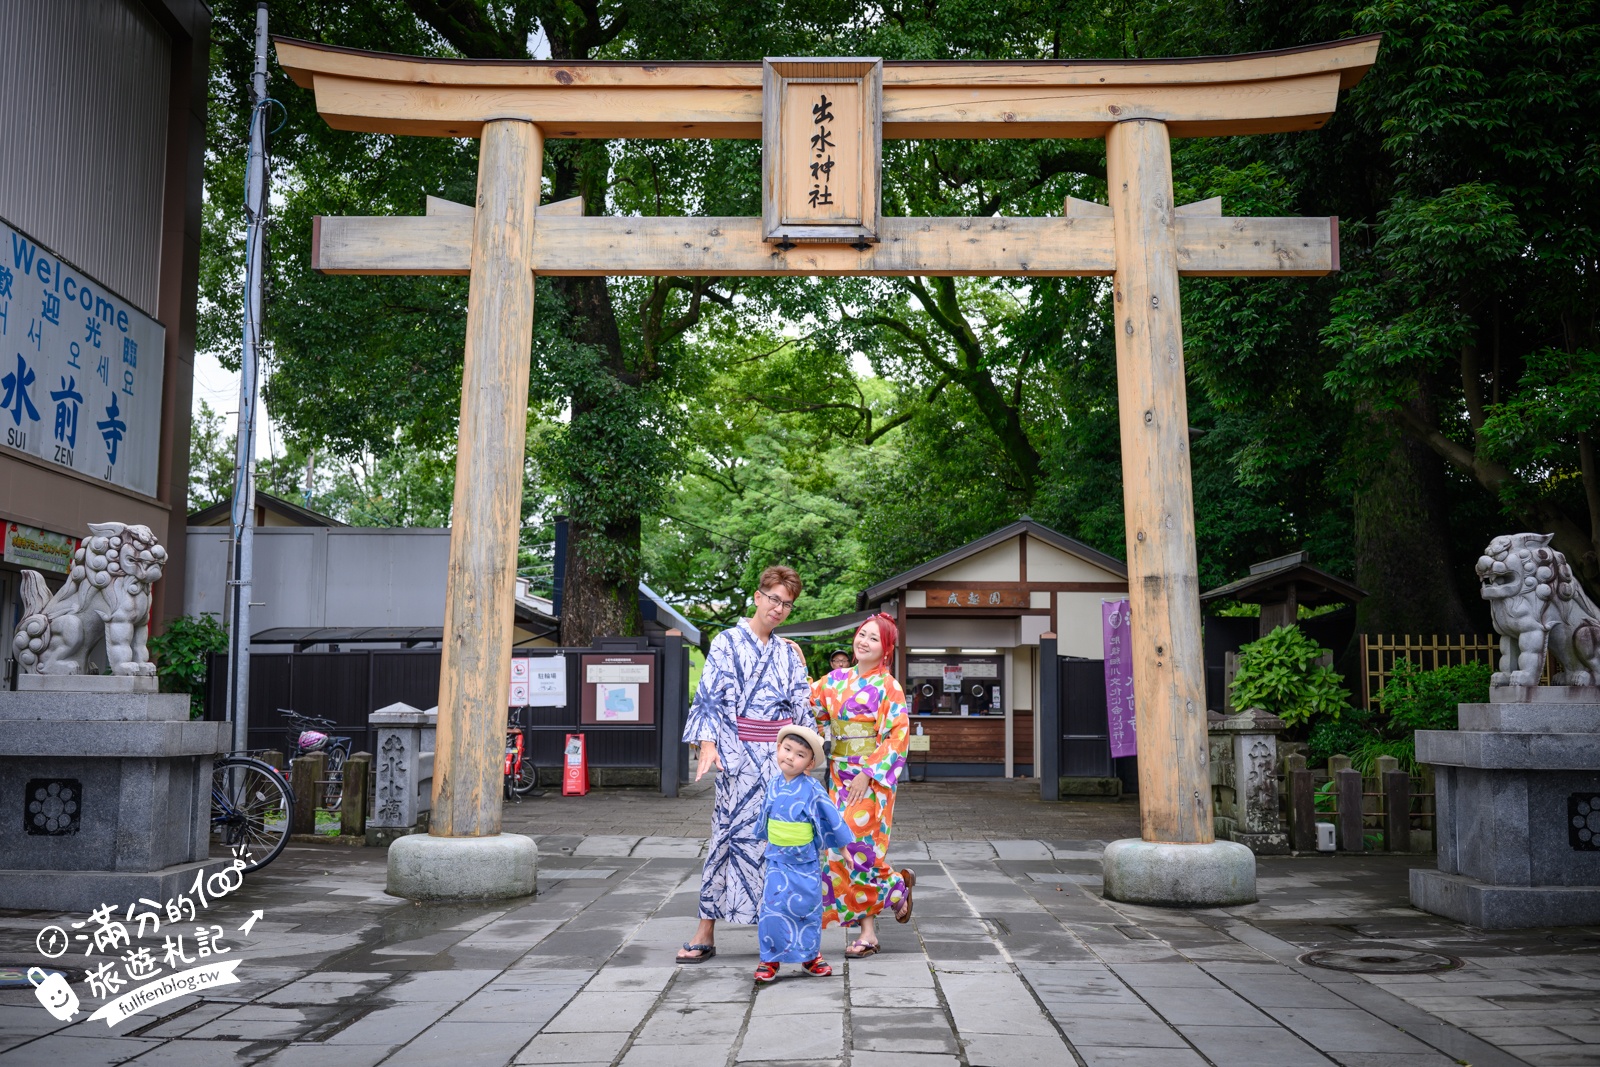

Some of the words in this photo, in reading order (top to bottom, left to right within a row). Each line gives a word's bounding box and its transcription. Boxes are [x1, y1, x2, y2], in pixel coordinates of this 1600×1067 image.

[808, 94, 836, 209] 出水神社
[12, 232, 130, 333] Welcome
[0, 352, 127, 466] 水前寺
[7, 427, 26, 450] SUI
[54, 444, 74, 467] ZEN
[103, 464, 112, 482] JI
